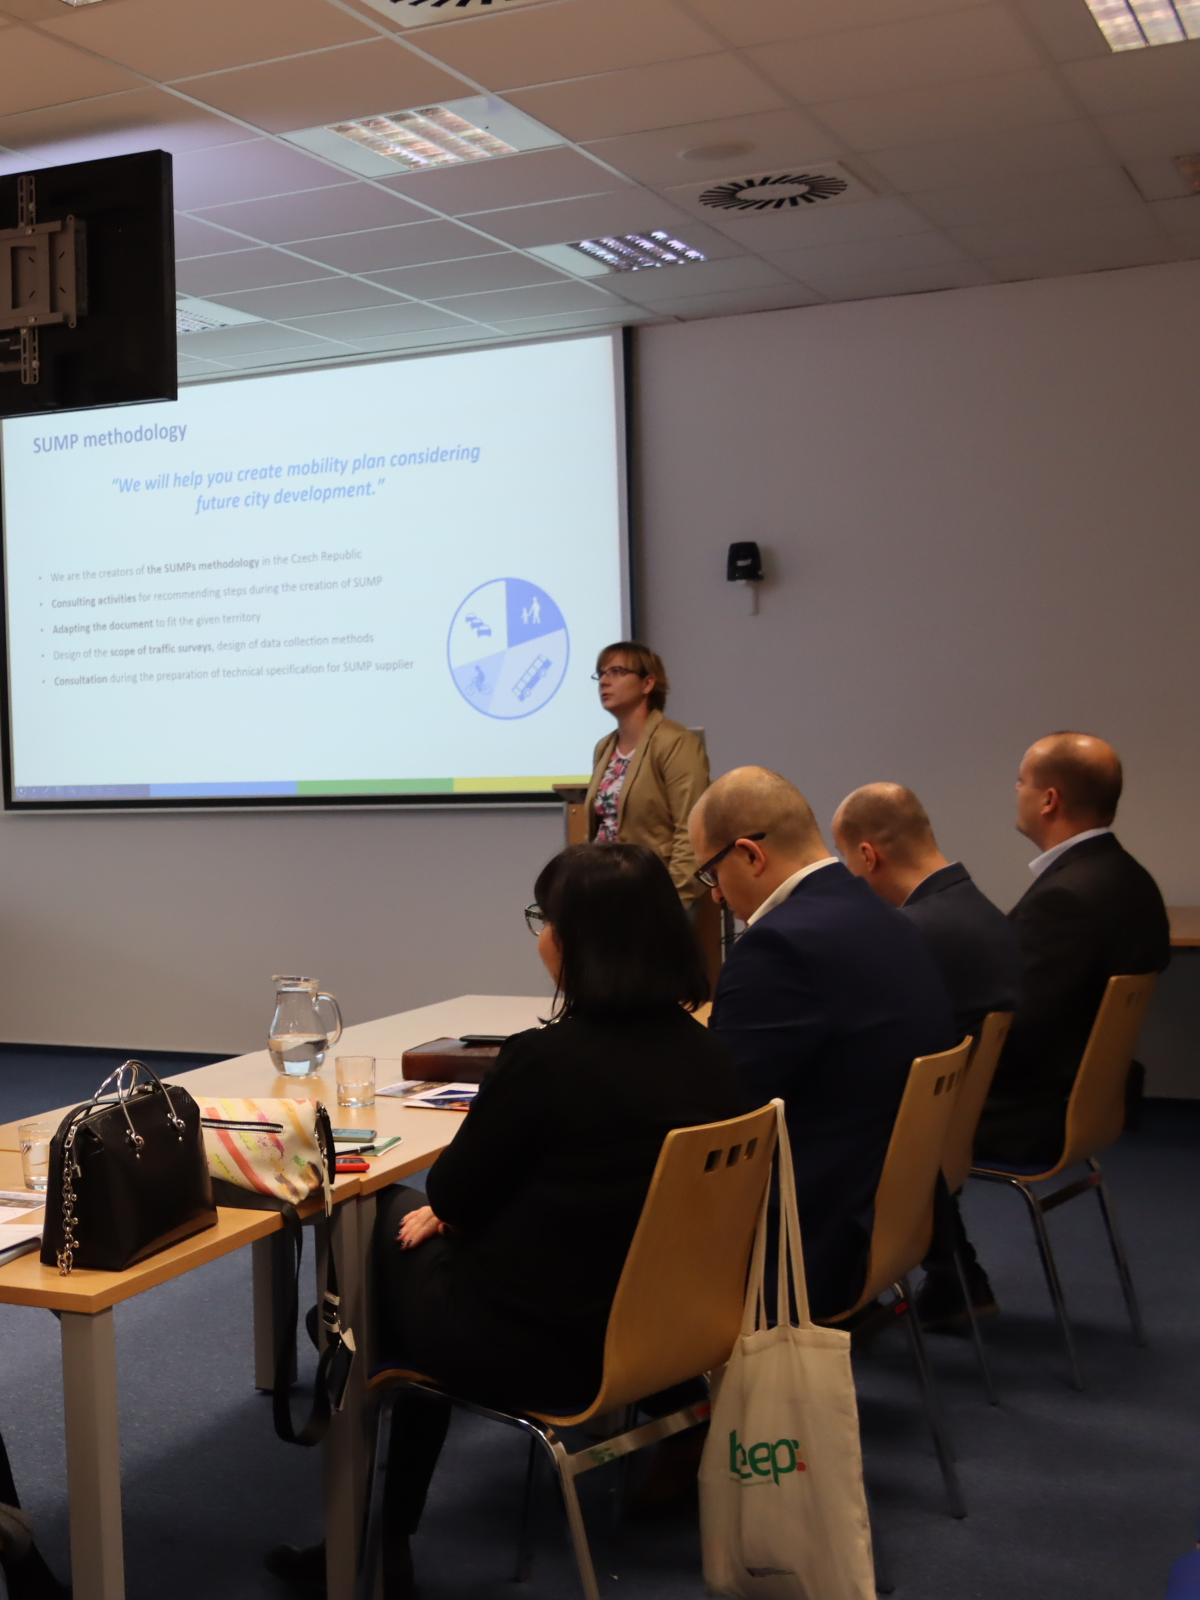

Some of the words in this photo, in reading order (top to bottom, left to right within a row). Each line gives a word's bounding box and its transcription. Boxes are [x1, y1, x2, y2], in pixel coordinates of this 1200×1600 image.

[33, 434, 78, 454] SUMP
[83, 423, 187, 448] methodology
[145, 473, 169, 490] will
[173, 470, 203, 489] help
[207, 471, 233, 488] you
[237, 464, 282, 481] create
[287, 456, 348, 476] mobility
[352, 453, 385, 474] plan
[390, 445, 480, 467] considering
[195, 494, 240, 515] future
[244, 491, 270, 509] city
[50, 573, 64, 582] We
[67, 572, 80, 581] are
[83, 569, 96, 579] the
[99, 567, 133, 578] creators
[136, 565, 146, 575] of
[147, 564, 161, 574] the
[164, 562, 196, 573] SUMPs
[198, 557, 259, 570] methodology
[262, 556, 270, 566] in
[273, 555, 289, 565] the
[291, 552, 318, 564] Czech
[321, 549, 362, 562] Republic
[51, 597, 96, 609] Consulting
[98, 594, 136, 605] activities
[138, 592, 151, 602] for
[154, 587, 220, 600] recommending
[223, 587, 247, 598] steps
[249, 583, 279, 595] during
[281, 582, 296, 593] the
[299, 579, 338, 592] creation
[341, 578, 351, 588] of
[353, 576, 383, 588] SUMP
[53, 624, 90, 635] Adapting
[93, 622, 106, 632] the
[109, 619, 153, 631] document
[156, 618, 165, 628] to
[167, 617, 177, 627] fit
[179, 616, 193, 626] the
[196, 614, 220, 627] given
[222, 613, 261, 624] territory
[53, 650, 81, 661] Design
[83, 648, 93, 658] of
[94, 647, 108, 658] the
[110, 648, 135, 658] scope
[138, 645, 147, 655] of
[149, 644, 175, 654] traffic
[178, 644, 215, 655] surveys,
[217, 640, 246, 652] design
[249, 639, 259, 649] of
[260, 638, 281, 648] data
[283, 635, 329, 647] collection
[331, 633, 374, 645] methods
[54, 674, 108, 686] Consultation
[110, 673, 137, 684] during
[140, 671, 154, 682] the
[156, 669, 208, 682] preparation
[211, 667, 221, 678] of
[223, 666, 263, 678] technical
[266, 663, 324, 676] specification
[326, 662, 341, 672] for
[343, 660, 372, 672] SUMP
[375, 659, 414, 671] supplier
